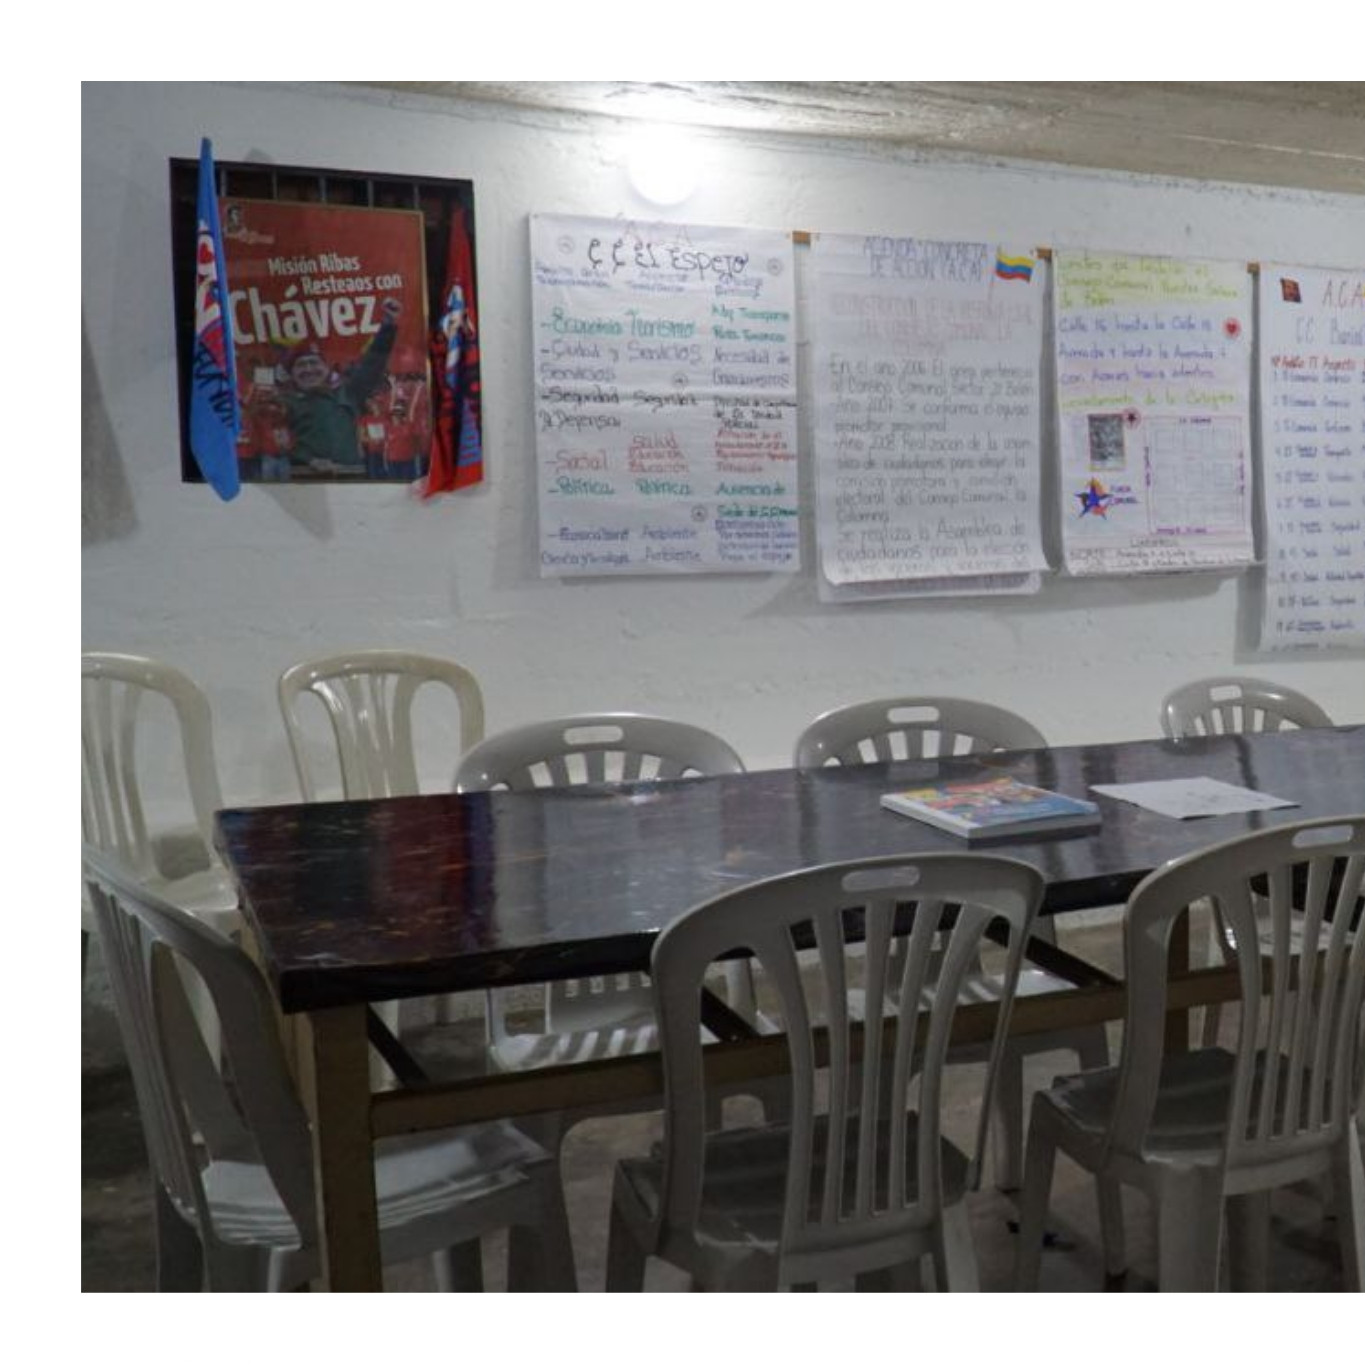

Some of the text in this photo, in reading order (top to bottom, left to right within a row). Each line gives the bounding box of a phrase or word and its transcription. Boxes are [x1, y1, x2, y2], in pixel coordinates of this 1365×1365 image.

[268, 252, 361, 277] Misión Ribas
[301, 273, 403, 296] Resteaos con
[229, 284, 382, 346] Chávez
